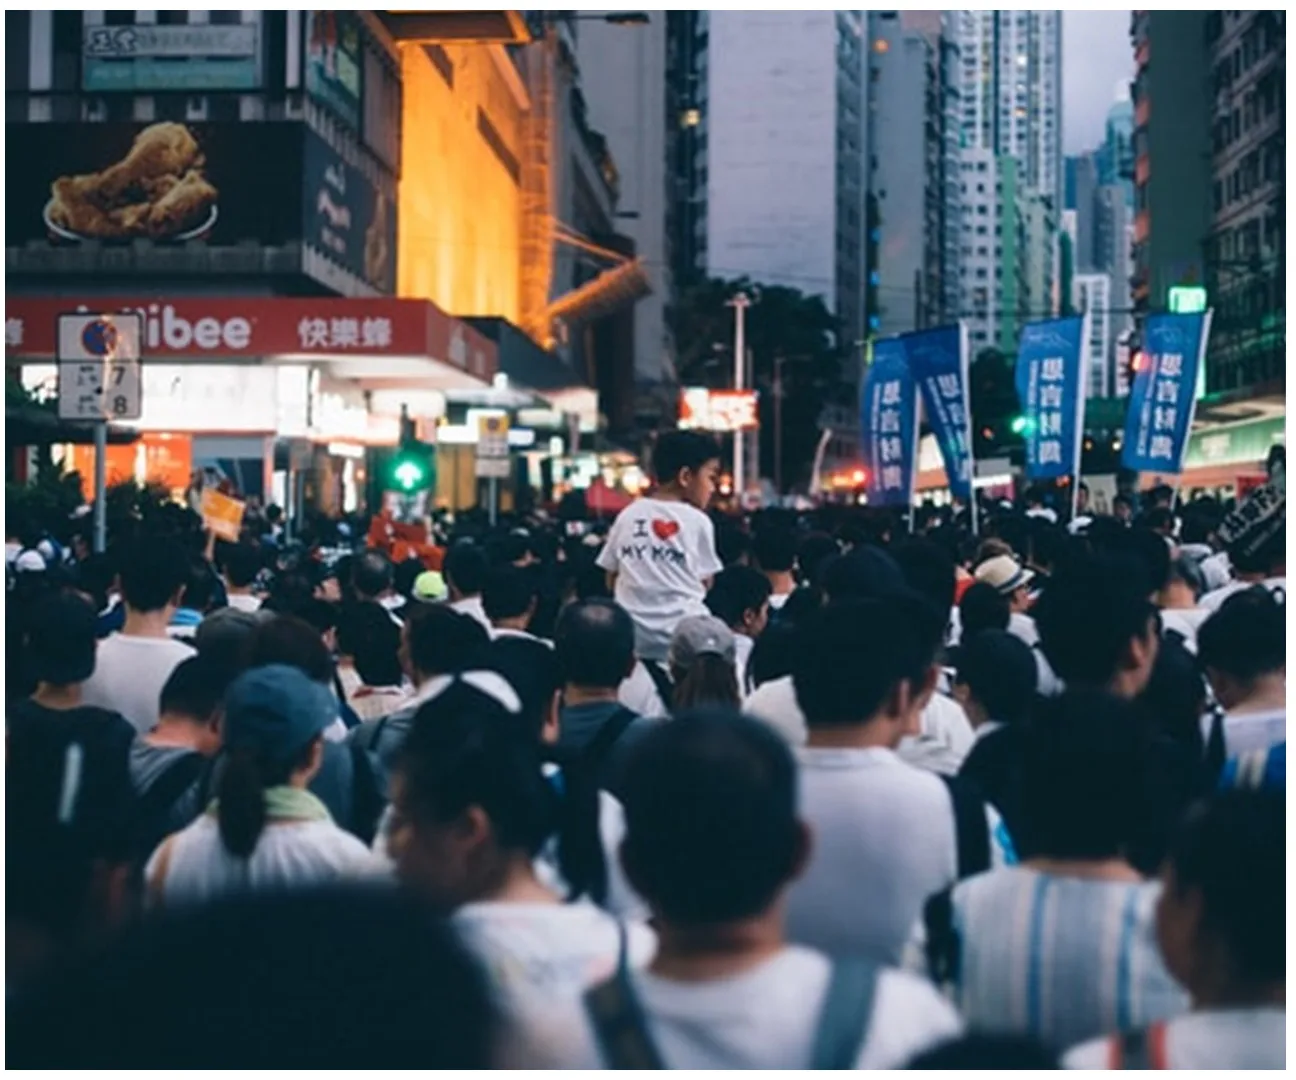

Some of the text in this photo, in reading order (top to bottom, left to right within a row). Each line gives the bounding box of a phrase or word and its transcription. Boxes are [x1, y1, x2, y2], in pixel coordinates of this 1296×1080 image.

[298, 317, 392, 348] 快樂蜂
[112, 366, 126, 385] 7
[114, 395, 127, 414] 8
[633, 519, 648, 537] I
[621, 545, 646, 559] MY
